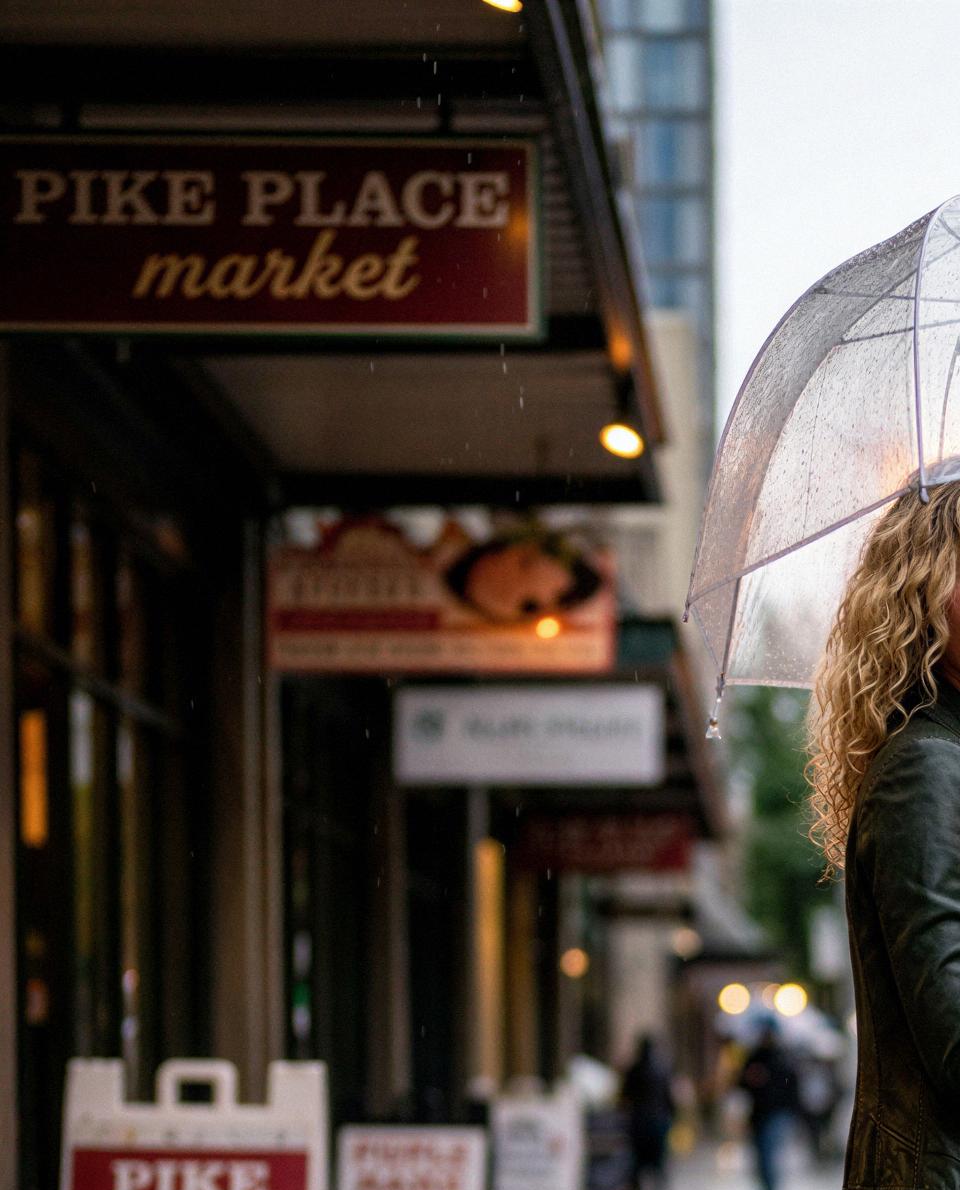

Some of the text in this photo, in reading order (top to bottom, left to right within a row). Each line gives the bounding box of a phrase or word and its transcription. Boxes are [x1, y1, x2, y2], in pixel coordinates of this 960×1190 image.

[13, 169, 510, 229] PIKE PLACE
[132, 230, 420, 299] market
